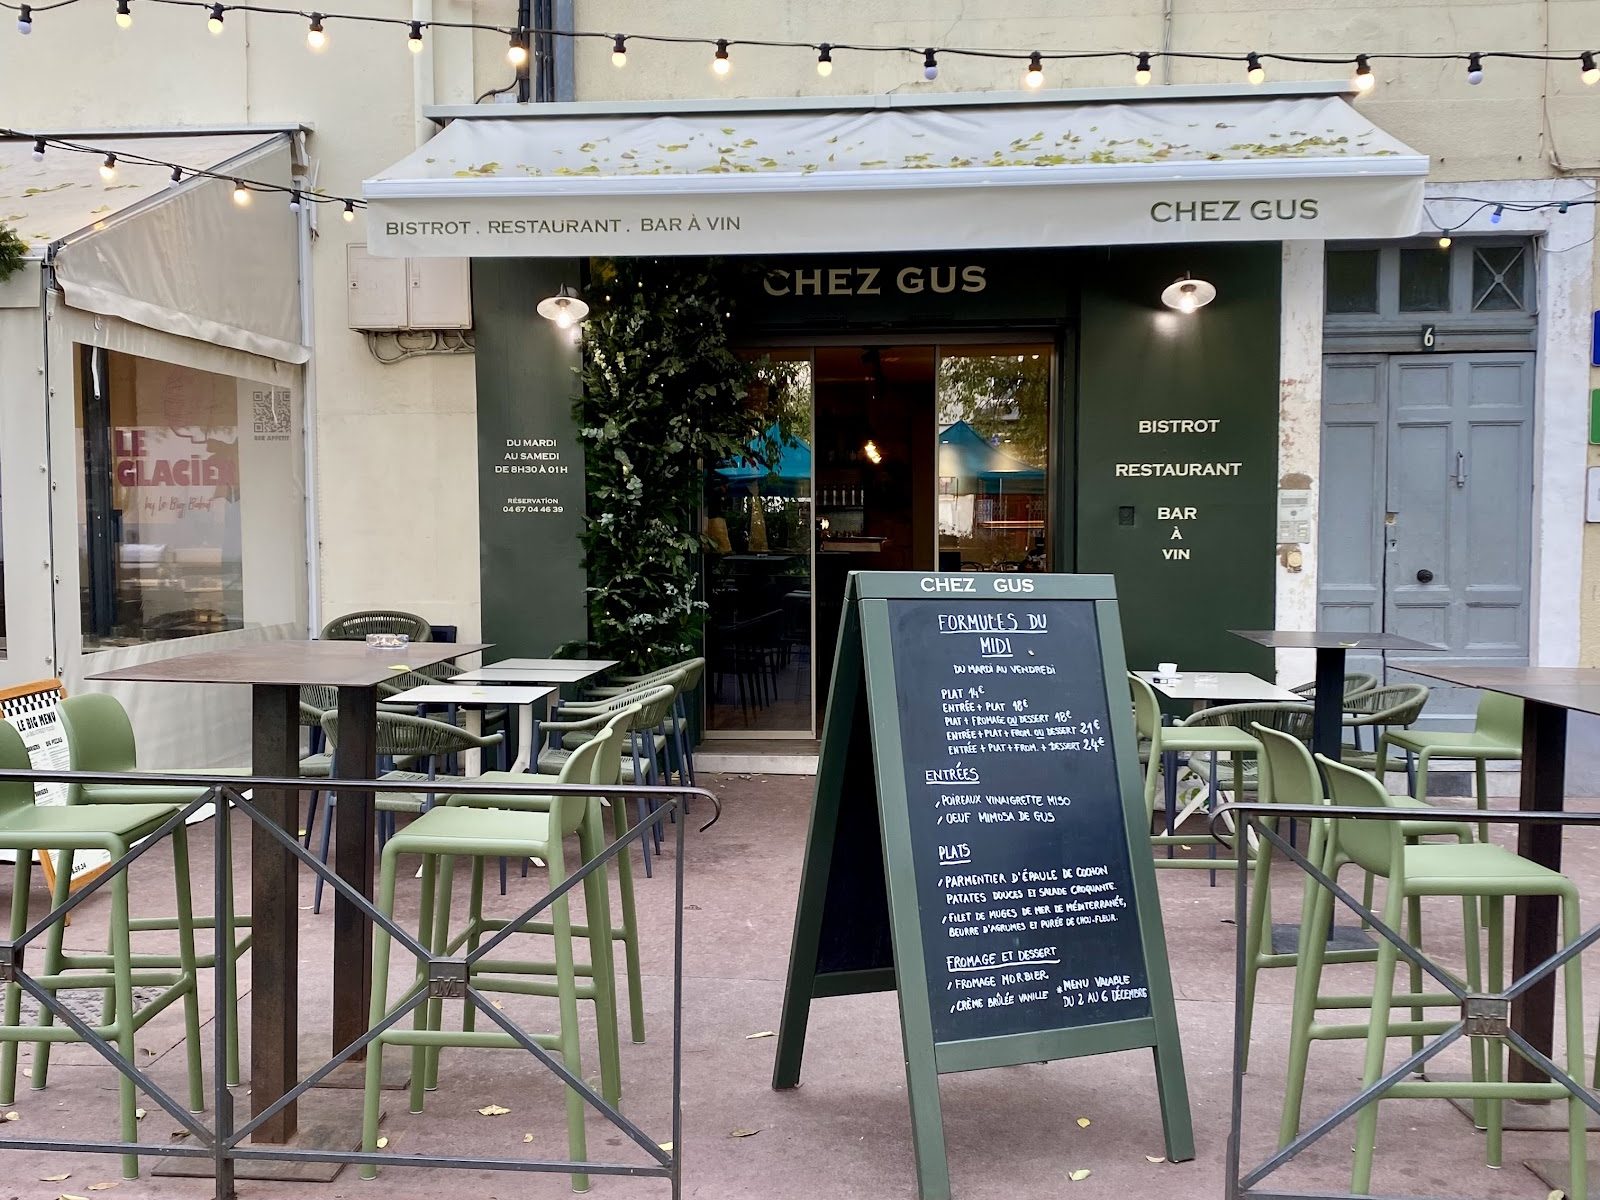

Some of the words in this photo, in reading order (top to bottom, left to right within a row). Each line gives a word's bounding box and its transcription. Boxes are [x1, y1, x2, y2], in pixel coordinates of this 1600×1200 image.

[1150, 201, 1240, 222] CHEZ
[1250, 199, 1319, 220] GUS
[386, 221, 470, 235] BISTROT
[488, 219, 622, 234] RESTAURANT
[640, 218, 682, 232] BAR
[688, 214, 701, 231] À
[706, 216, 740, 230] VIN
[763, 268, 880, 296] CHEZ
[896, 265, 987, 294] GUS
[1424, 328, 1434, 346] 6
[1138, 419, 1220, 433] BISTROT
[115, 430, 146, 456] LE
[539, 464, 546, 473] À
[1115, 463, 1242, 476] RESTAURANT
[1157, 507, 1197, 520] BAR
[1170, 526, 1182, 540] À
[1162, 549, 1190, 560] VIN
[920, 578, 976, 592] CHEZ
[993, 578, 1035, 592] GUS
[1027, 614, 1047, 629] DU
[980, 637, 1013, 654] MIDI
[954, 664, 966, 674] DU
[996, 665, 1008, 674] AU
[941, 688, 964, 700] PLAT
[968, 685, 985, 699] 14€
[942, 700, 975, 713] ENTRÉE
[986, 702, 1006, 712] PLAT
[1012, 699, 1028, 712] 18€
[17, 718, 26, 732] LE
[27, 716, 38, 729] BIG
[39, 712, 56, 726] MENU
[944, 716, 962, 726] PLAT
[972, 716, 1006, 726] FROMAGE
[1007, 716, 1018, 725] OU
[1019, 714, 1050, 724] DESSERT
[1055, 710, 1072, 723] 18€
[946, 728, 977, 740] ENTRÉE
[984, 729, 1002, 738] PLAT
[1034, 729, 1044, 737] OU
[1046, 726, 1077, 736] DESSERT
[1079, 719, 1101, 735] 21€
[948, 742, 977, 756] ENTRÉE
[988, 743, 1006, 752] PLAT
[1048, 741, 1080, 751] DESSERT
[1083, 737, 1105, 752] 24€
[925, 761, 980, 782] ENTRÉES
[986, 794, 1043, 806] VINAIGRETTE
[1047, 795, 1071, 806] MISO
[946, 812, 971, 824] OEUF
[978, 811, 1015, 823] MIMOSA
[1018, 811, 1030, 822] DE
[1034, 811, 1056, 823] GUS
[938, 843, 971, 860] PLATS
[945, 873, 1007, 888] PARMENTIER
[1011, 868, 1058, 884] D'ÉPAULE
[1063, 868, 1073, 879] DE
[1076, 865, 1108, 878] COCHON
[946, 892, 986, 905] PATATES
[992, 889, 1023, 900] DOUCES
[1028, 888, 1037, 898] ET
[1039, 886, 1068, 898] SALADE
[948, 911, 971, 923] FILET
[975, 910, 986, 922] DE
[989, 908, 1018, 920] MUGES
[1021, 907, 1032, 917] DE
[1034, 904, 1051, 915] MER
[1054, 903, 1064, 914] DE
[948, 926, 979, 938] BEURRE
[983, 922, 1026, 934] D'AGRUMES
[1029, 921, 1038, 930] ET
[1040, 916, 1064, 929] PURÉE
[1066, 917, 1075, 927] DE
[946, 952, 996, 968] FROMAGE
[1001, 951, 1013, 962] ET
[1017, 946, 1058, 961] DESSERT
[955, 976, 996, 989] FROMAGE
[1001, 970, 1049, 986] MORBIER
[1094, 975, 1130, 987] VALABLE
[956, 998, 984, 1012] CRÈME
[988, 992, 1014, 1008] BRÛLÉE
[1018, 990, 1049, 1003] VANILLE
[1063, 995, 1075, 1008] DU
[1077, 994, 1084, 1006] 2
[1088, 992, 1099, 1003] AU
[1101, 990, 1108, 1002] 6
[1112, 984, 1148, 1001] DÉCEMBRE
